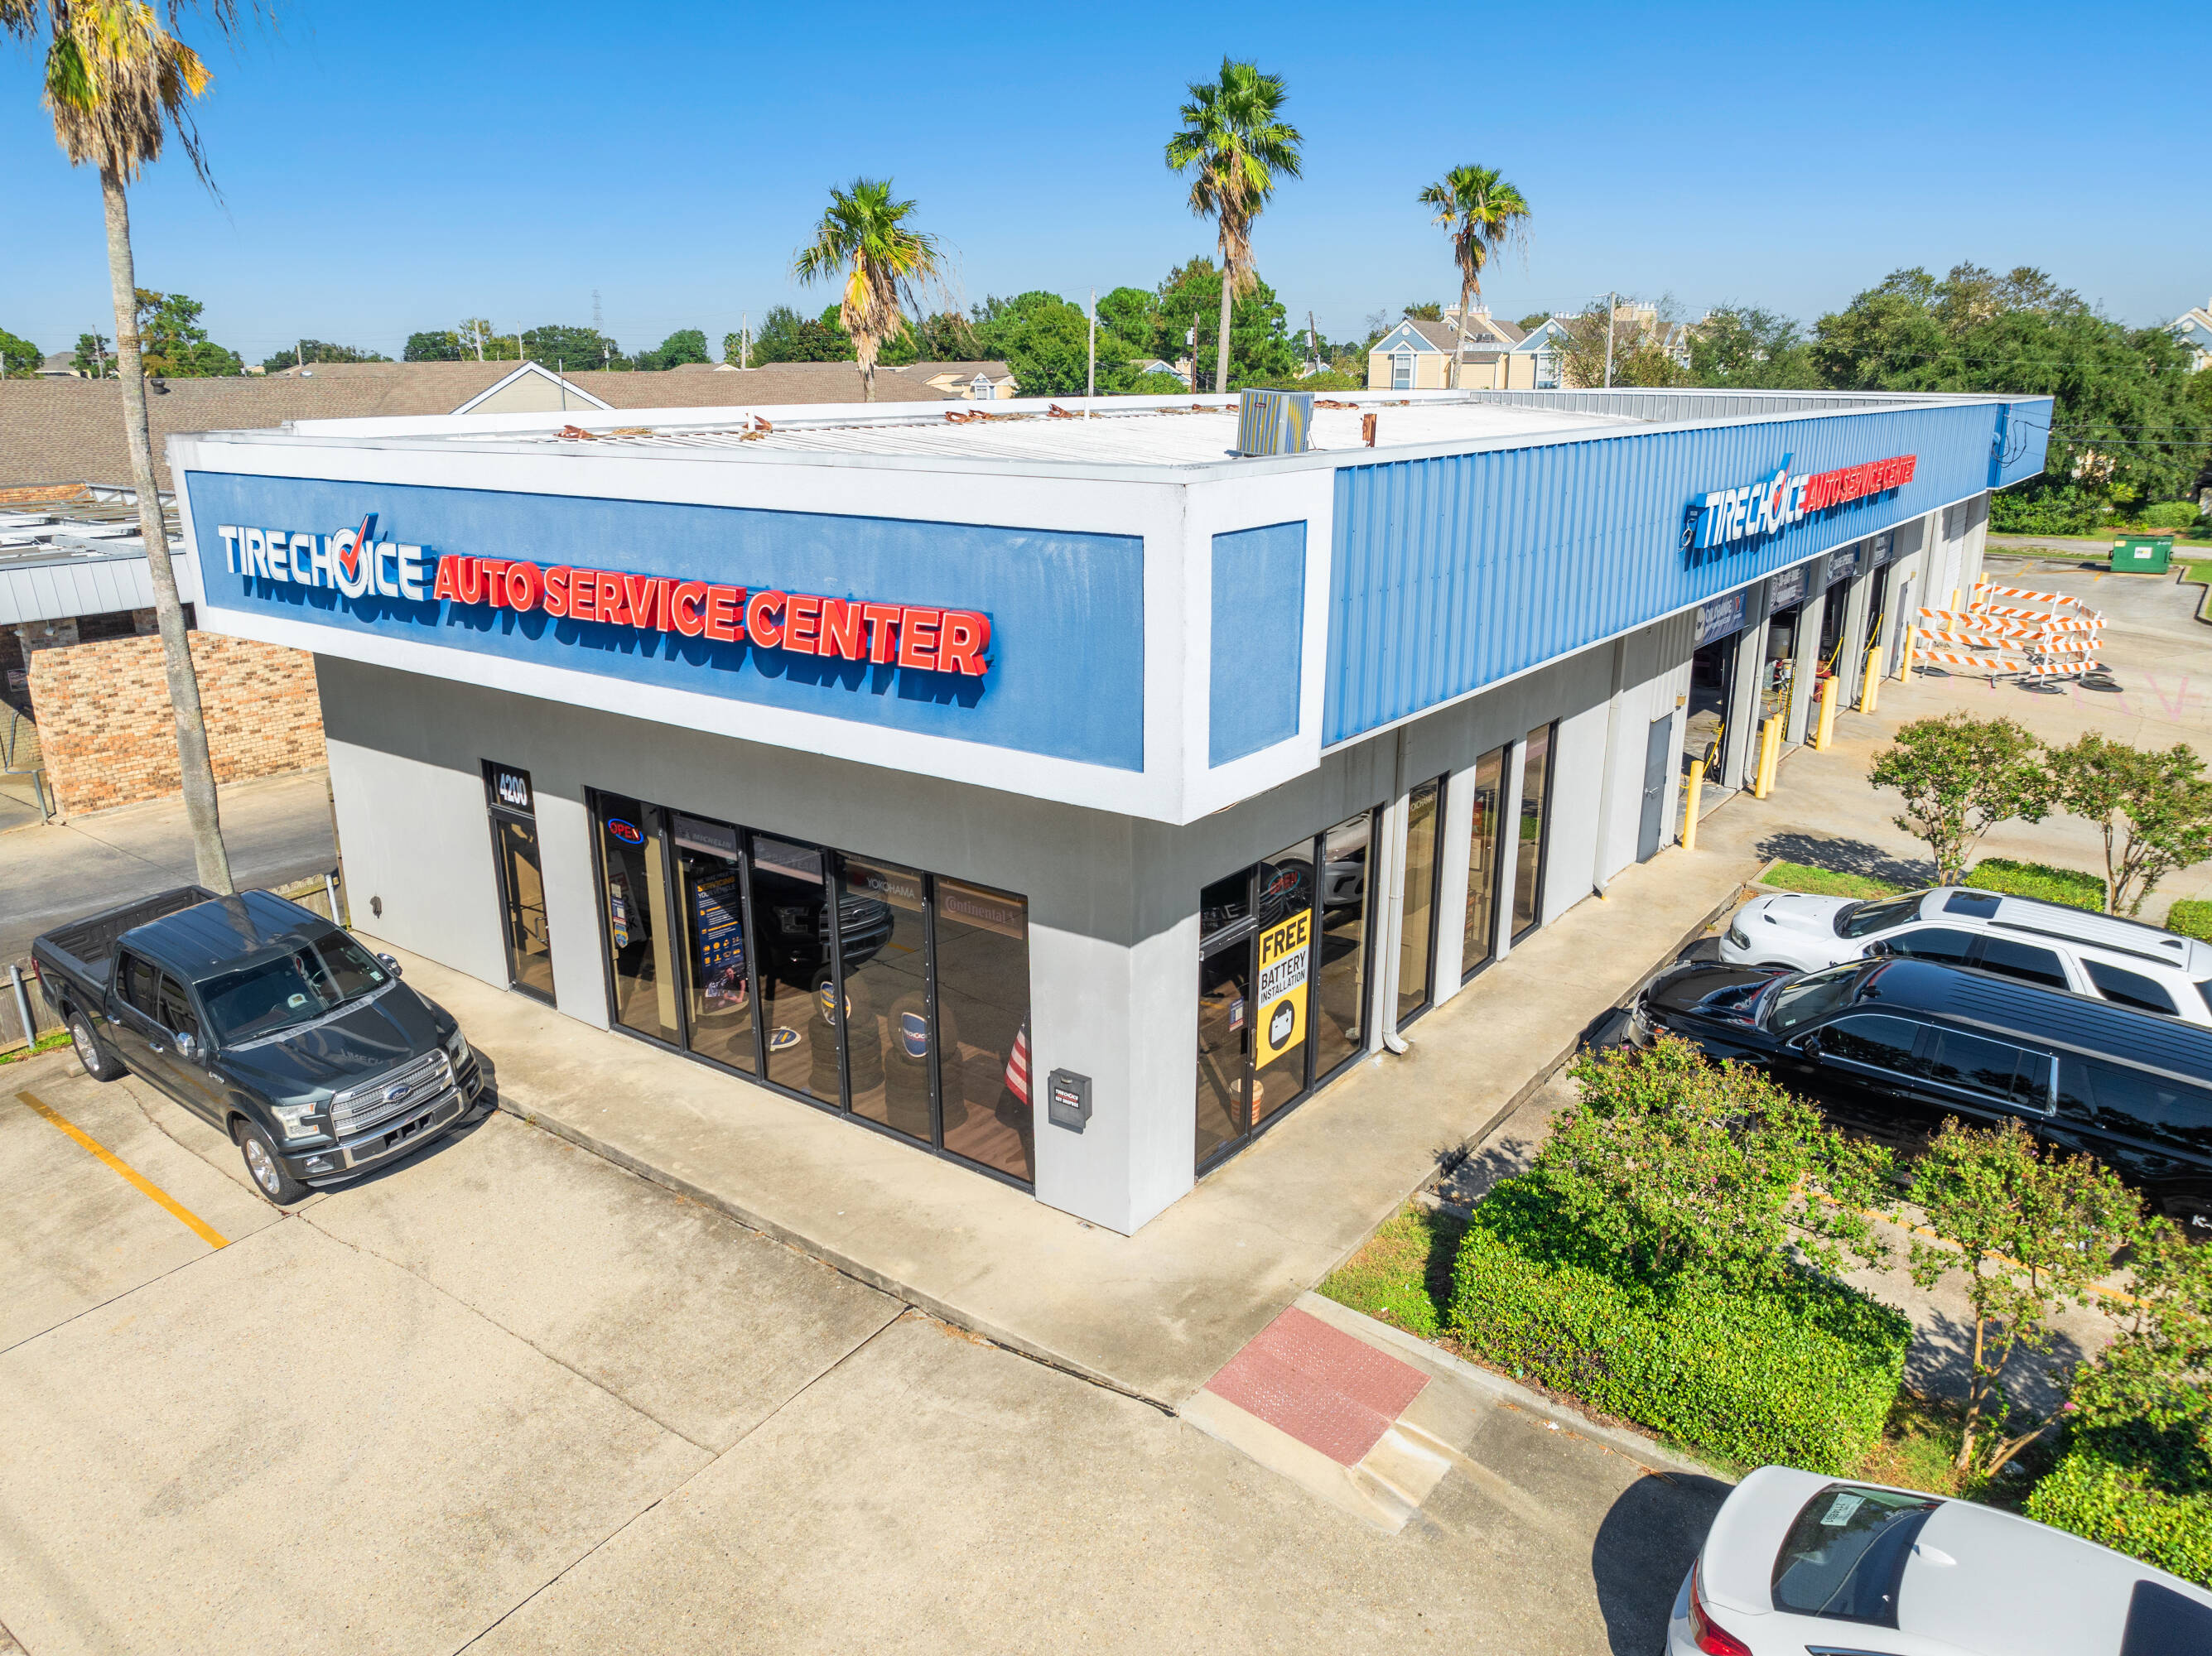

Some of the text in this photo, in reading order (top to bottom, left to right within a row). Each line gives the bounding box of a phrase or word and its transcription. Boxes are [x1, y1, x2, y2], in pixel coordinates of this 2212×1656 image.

[1804, 471, 1840, 513] AUTO
[1839, 461, 1884, 503] SERVICE
[433, 554, 544, 613] AUTO
[543, 565, 746, 643] SERVICE
[747, 590, 990, 676] CENTER
[499, 773, 528, 806] 4200
[610, 822, 640, 840] OPEN
[692, 832, 732, 849] MICHELIN
[866, 877, 915, 899] YOKOHAMA
[945, 896, 1005, 923] Continental
[1262, 917, 1308, 965] FREE
[1260, 969, 1306, 1004] INSTALLATION
[1261, 951, 1306, 990] BATTERY
